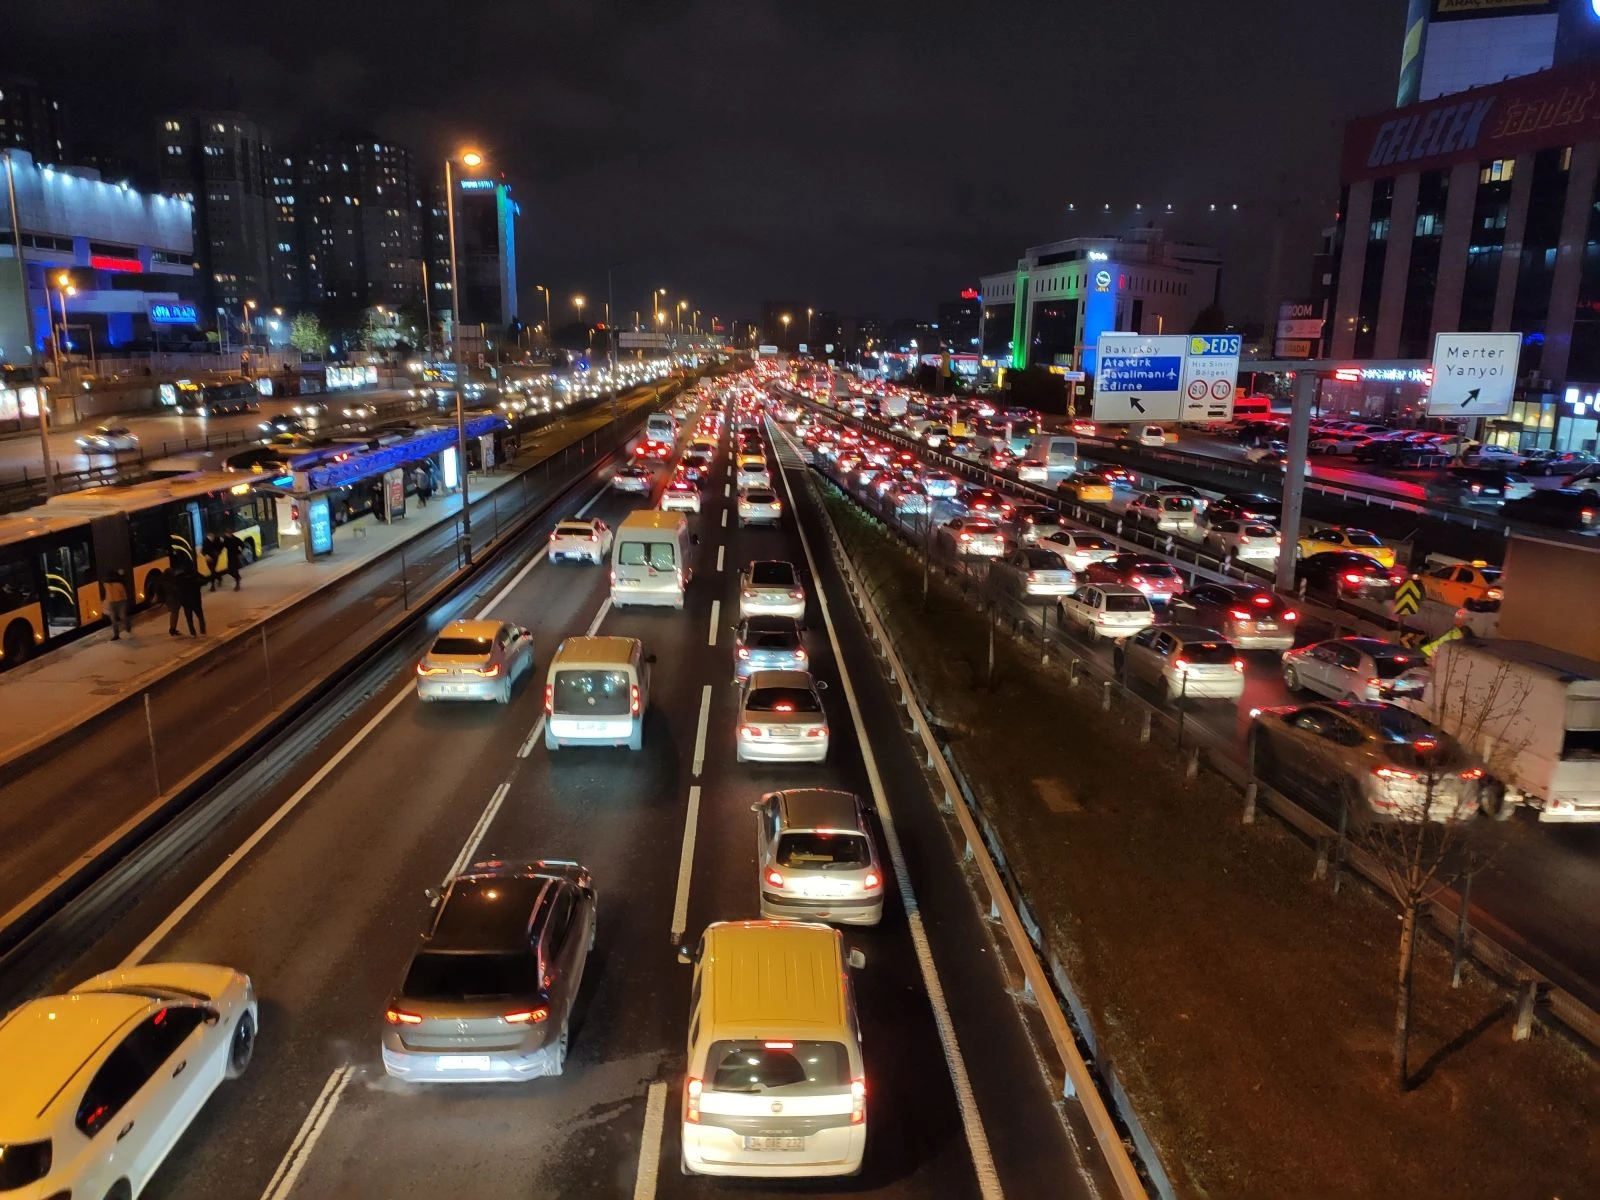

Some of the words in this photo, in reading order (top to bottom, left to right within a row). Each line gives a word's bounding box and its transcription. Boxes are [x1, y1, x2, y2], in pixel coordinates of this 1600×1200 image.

[1367, 96, 1496, 168] GELECEK
[1211, 338, 1238, 353] EDS
[1447, 346, 1504, 358] Merter
[1446, 364, 1504, 379] Yanyol
[1102, 381, 1143, 391] Edirne
[1192, 384, 1204, 395] 80
[1215, 384, 1228, 395] 70
